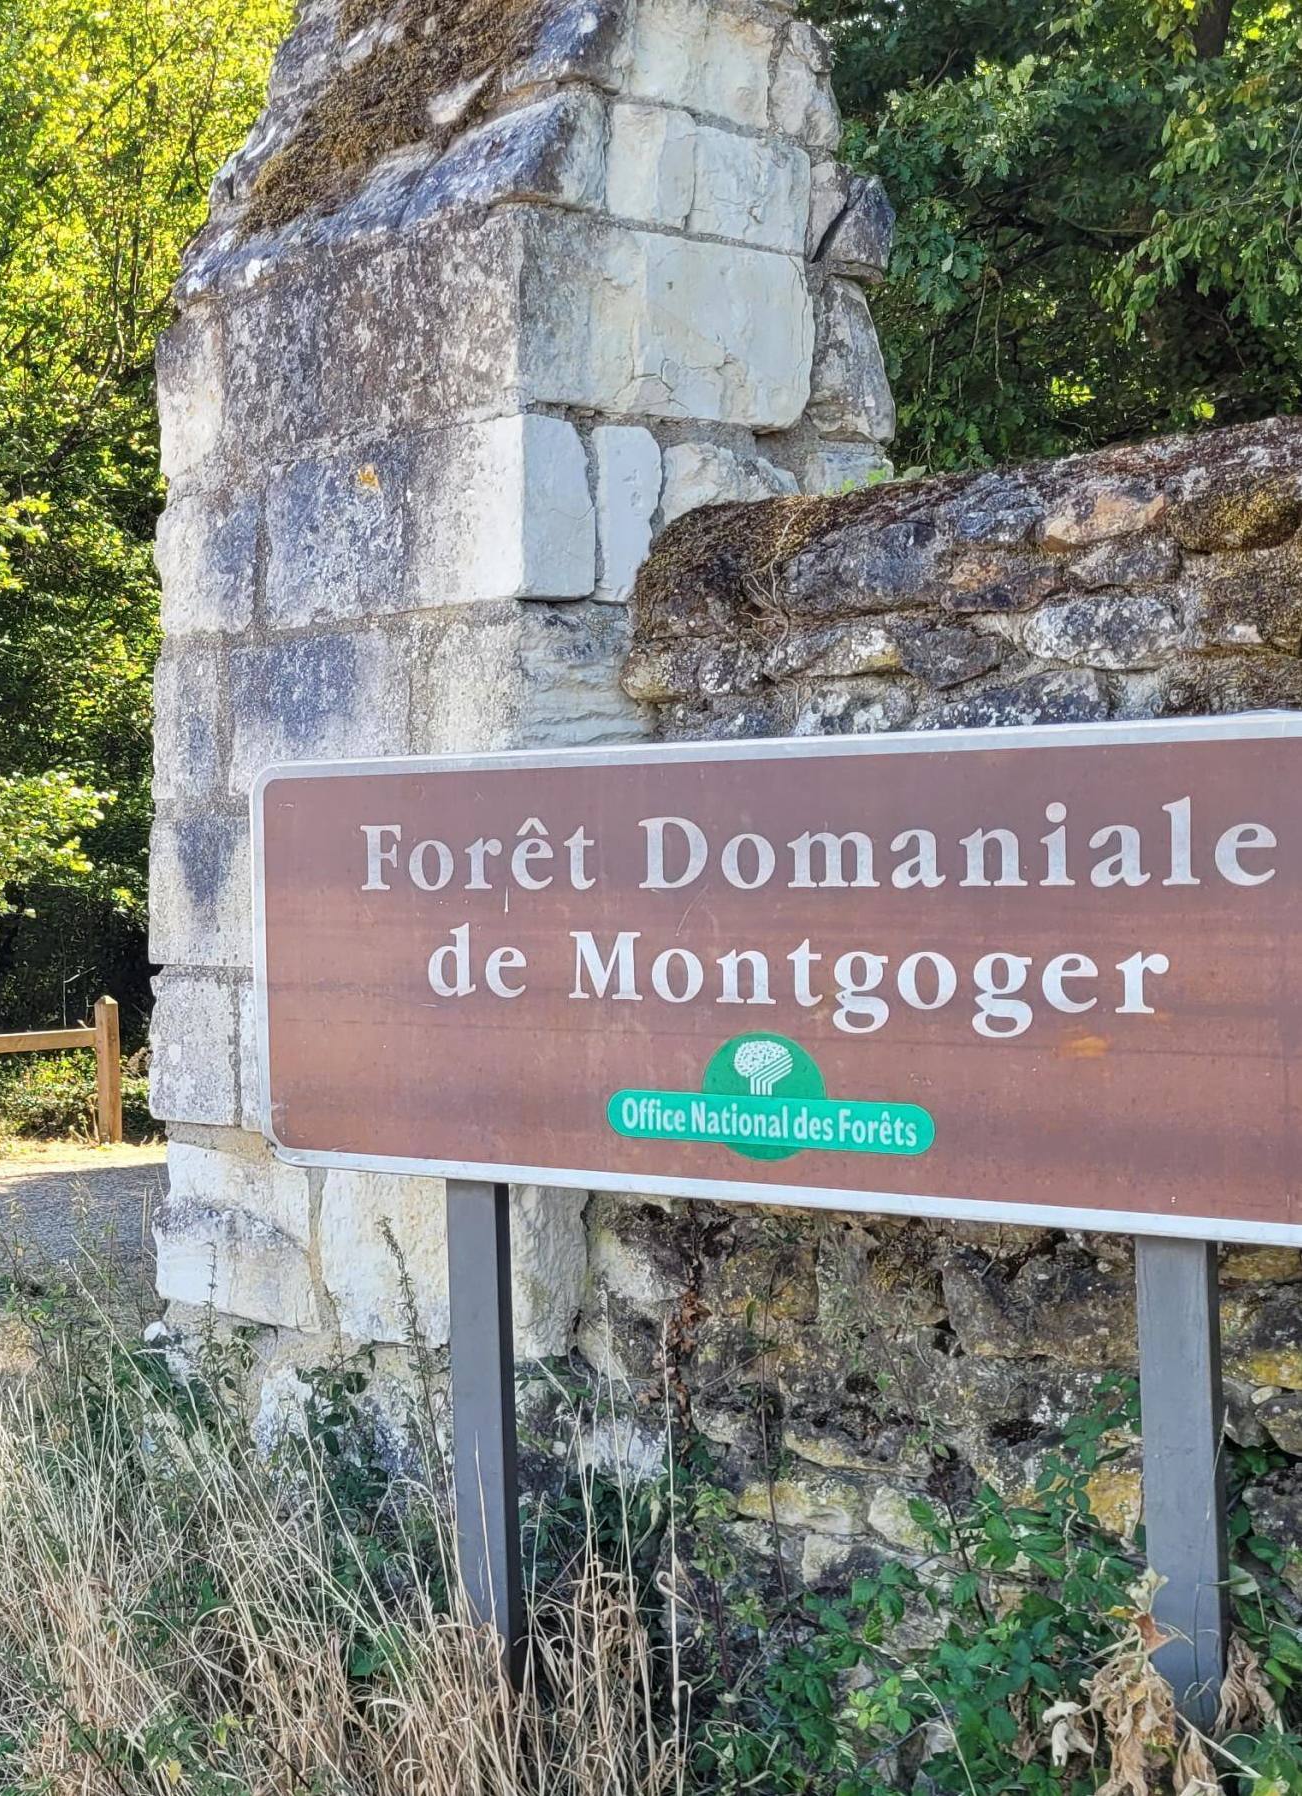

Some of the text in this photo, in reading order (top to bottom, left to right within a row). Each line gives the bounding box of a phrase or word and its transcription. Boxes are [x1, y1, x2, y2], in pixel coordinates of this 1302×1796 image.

[359, 795, 1278, 892] Forêt Domaniale
[427, 922, 1170, 1038] de Montgoger
[621, 1097, 918, 1147] Office National des Forêts
